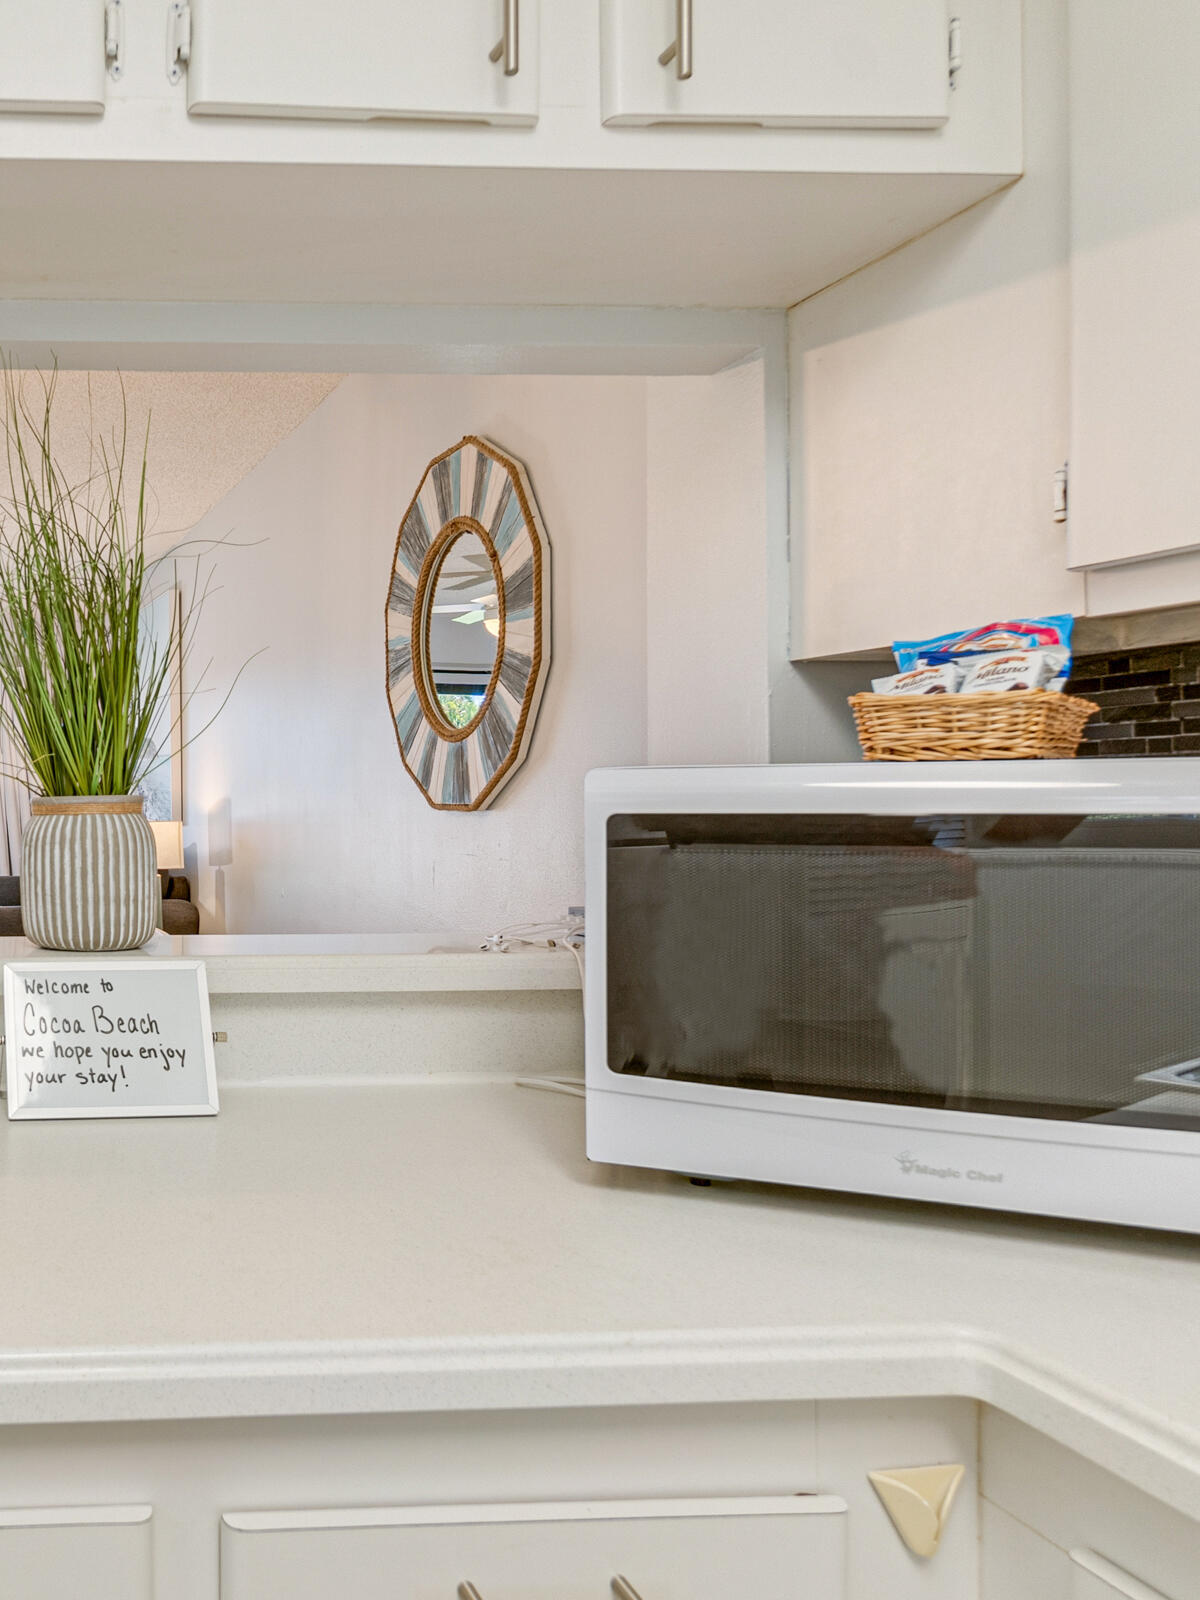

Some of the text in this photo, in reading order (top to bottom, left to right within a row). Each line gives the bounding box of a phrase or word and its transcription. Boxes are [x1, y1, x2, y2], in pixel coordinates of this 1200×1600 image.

[24, 978, 114, 995] Welcome to
[23, 1002, 160, 1036] Cocoa Beach
[21, 1041, 187, 1071] we hope you enjoy
[24, 1065, 129, 1092] your stay!
[915, 1163, 1004, 1183] Magic Chef
